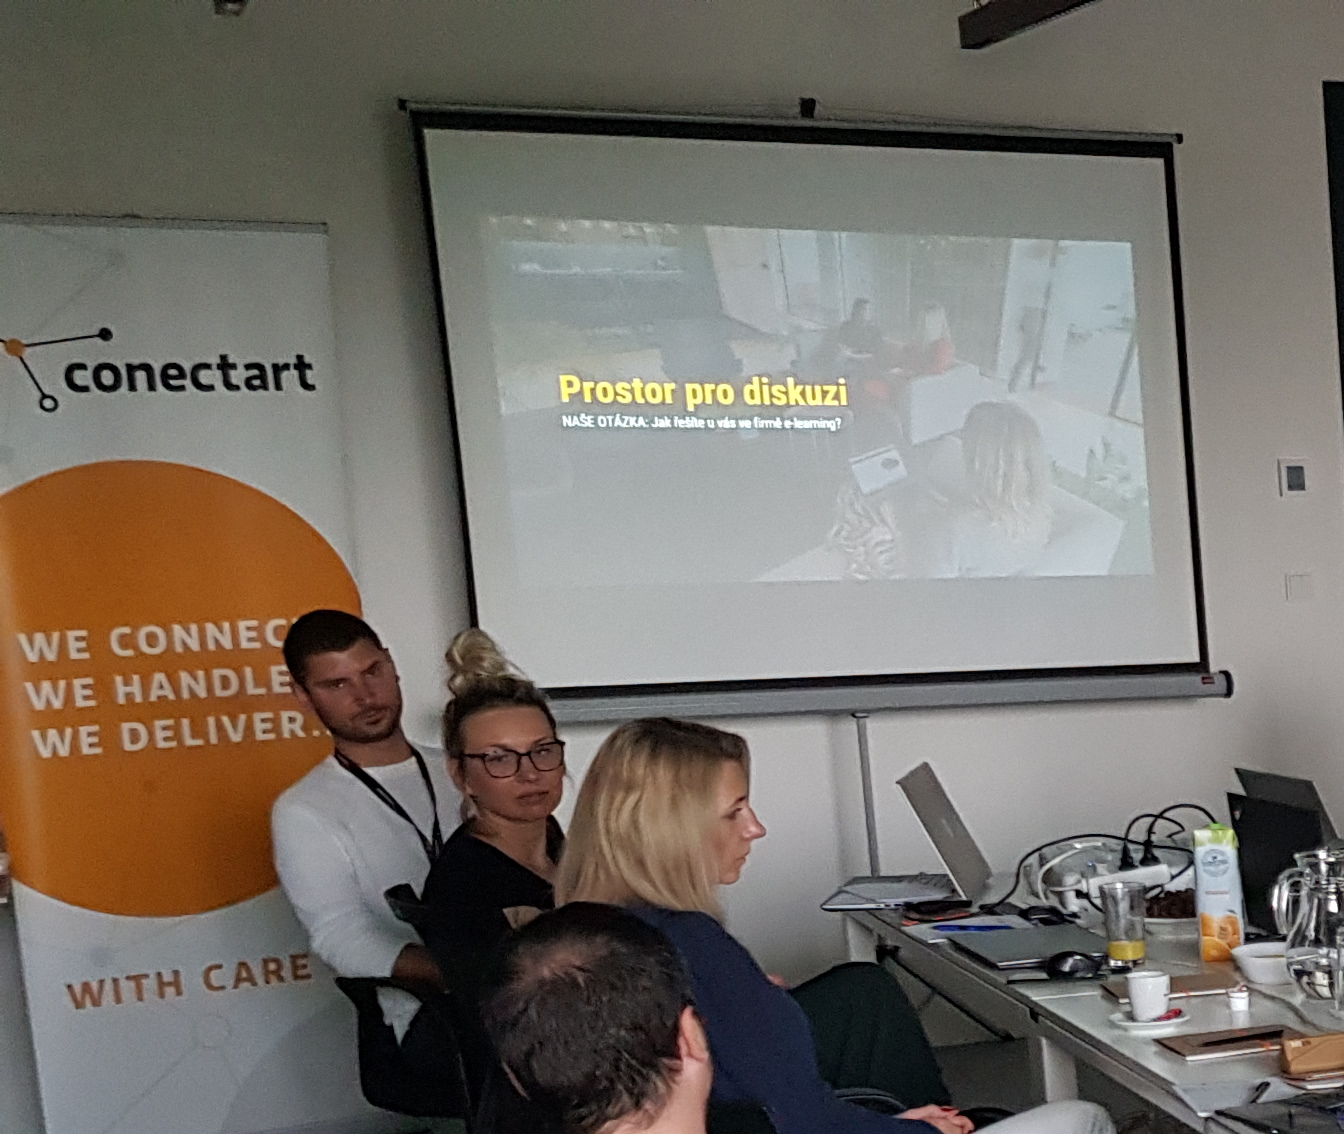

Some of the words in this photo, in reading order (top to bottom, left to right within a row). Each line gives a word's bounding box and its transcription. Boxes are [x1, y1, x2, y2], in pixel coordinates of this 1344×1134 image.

[63, 353, 317, 393] conectart
[559, 373, 676, 404] Prostor
[684, 381, 735, 412] pro
[743, 375, 849, 406] diskuzi
[562, 413, 595, 428] NAŠE
[597, 413, 649, 428] OTÁZKA:
[651, 415, 672, 428] Jak
[707, 418, 715, 428] u
[738, 418, 751, 429] ve
[16, 629, 91, 663] WE
[109, 618, 300, 657] CONNEC
[24, 676, 98, 711] WE
[114, 664, 293, 705] HANDLE
[30, 724, 104, 759] WE
[65, 968, 184, 1010] WITH
[202, 952, 312, 993] CARE
